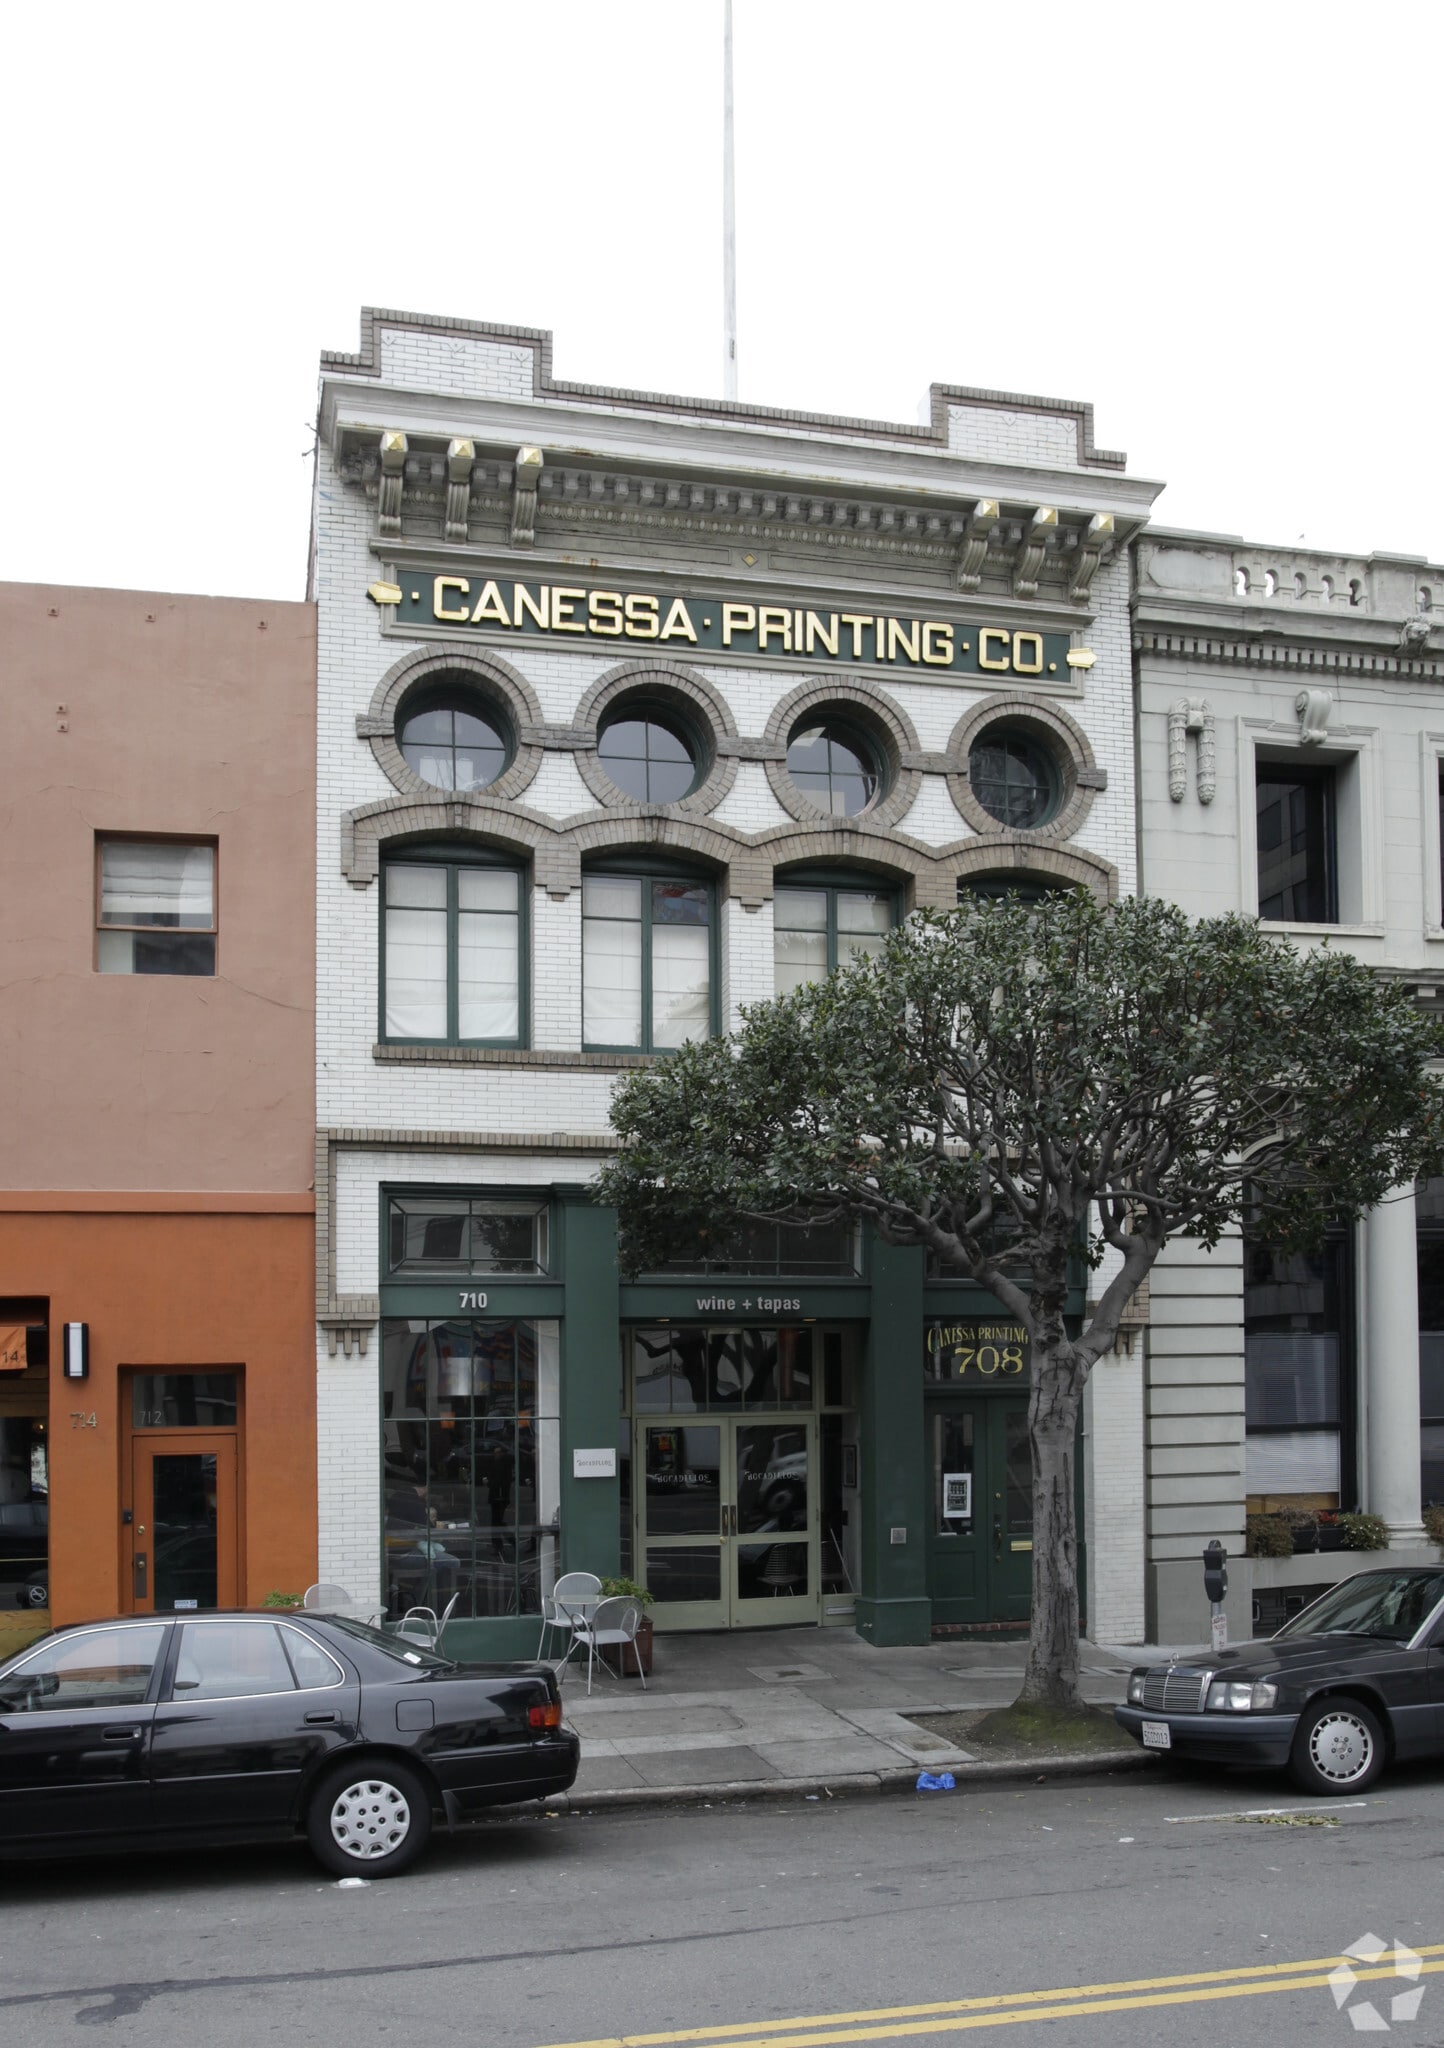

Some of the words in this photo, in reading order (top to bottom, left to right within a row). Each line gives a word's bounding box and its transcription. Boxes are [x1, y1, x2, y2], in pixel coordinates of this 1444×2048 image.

[432, 575, 698, 643] CANESSA
[722, 602, 955, 665] PRINTING
[978, 628, 1057, 673] CO.
[459, 1292, 488, 1308] 710
[696, 1295, 736, 1310] wine
[757, 1296, 801, 1314] tapas
[927, 1327, 976, 1354] CANESSA
[978, 1327, 1029, 1345] PRINTING
[954, 1346, 1023, 1374] 708
[70, 1412, 98, 1429] 714
[139, 1410, 162, 1424] 712
